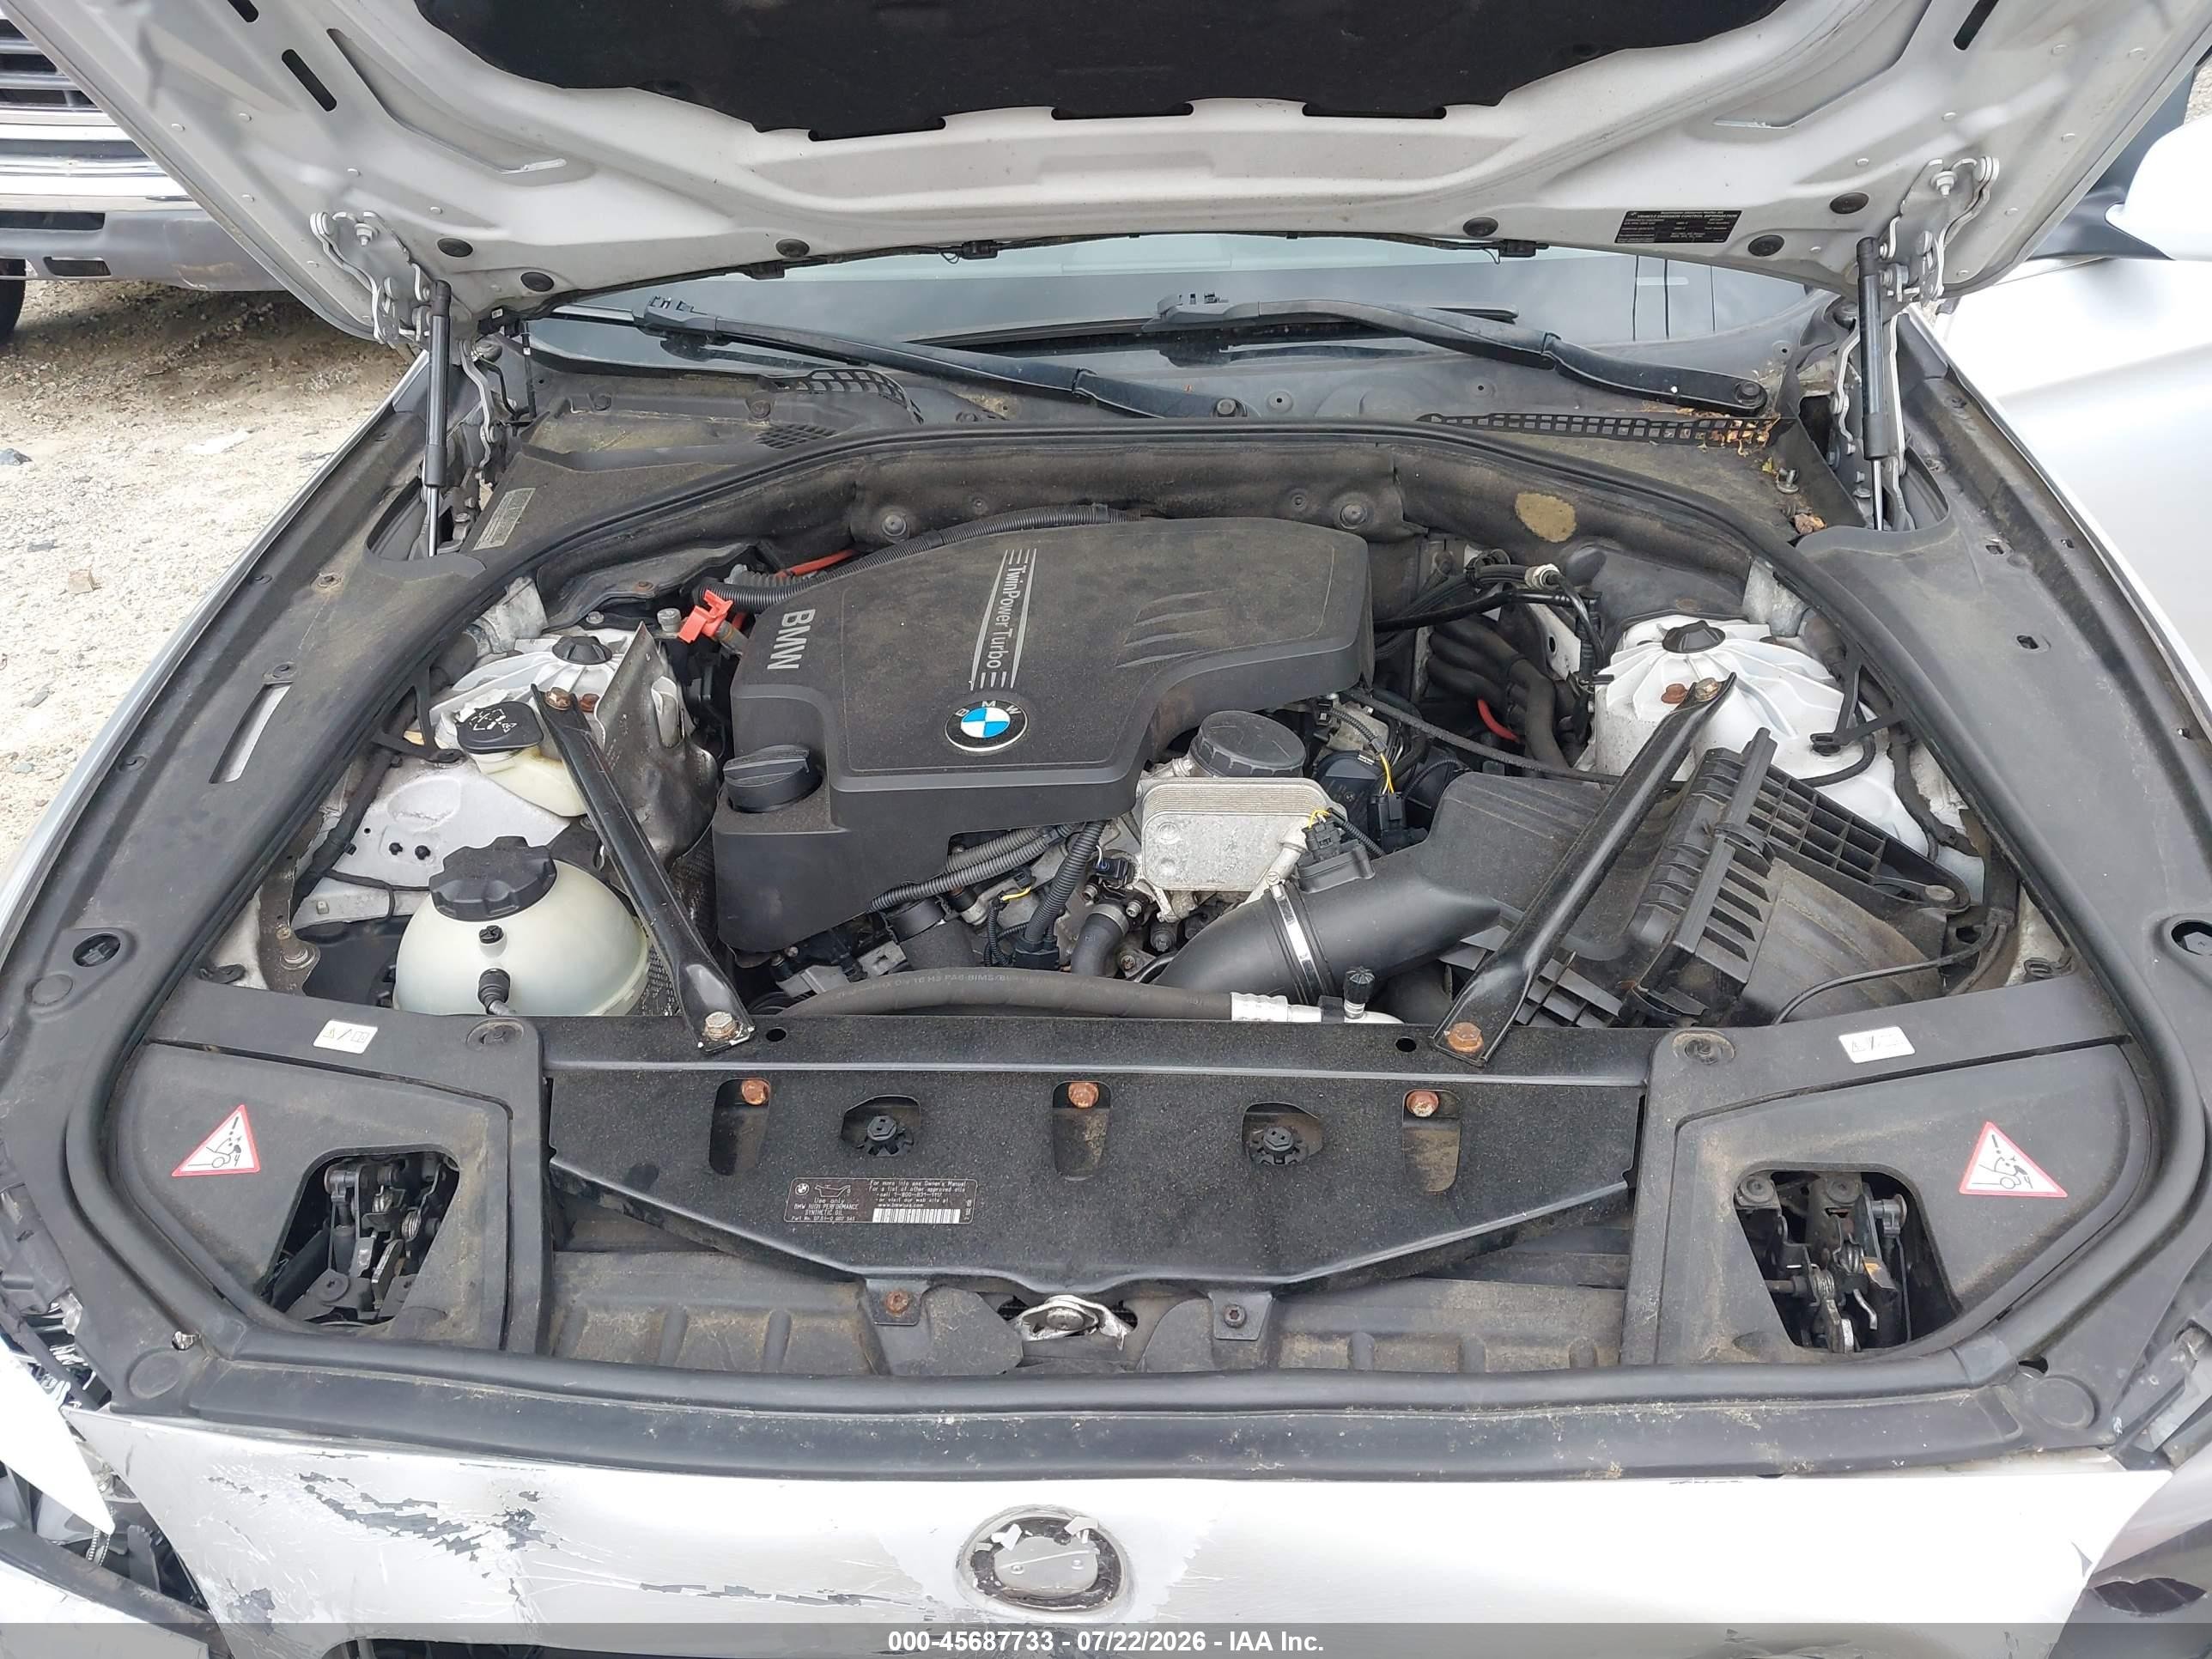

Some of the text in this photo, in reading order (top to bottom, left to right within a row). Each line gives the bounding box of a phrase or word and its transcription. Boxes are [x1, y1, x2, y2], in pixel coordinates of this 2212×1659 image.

[767, 609, 816, 670] BMW
[986, 563, 1027, 669] TwinPower Turbo
